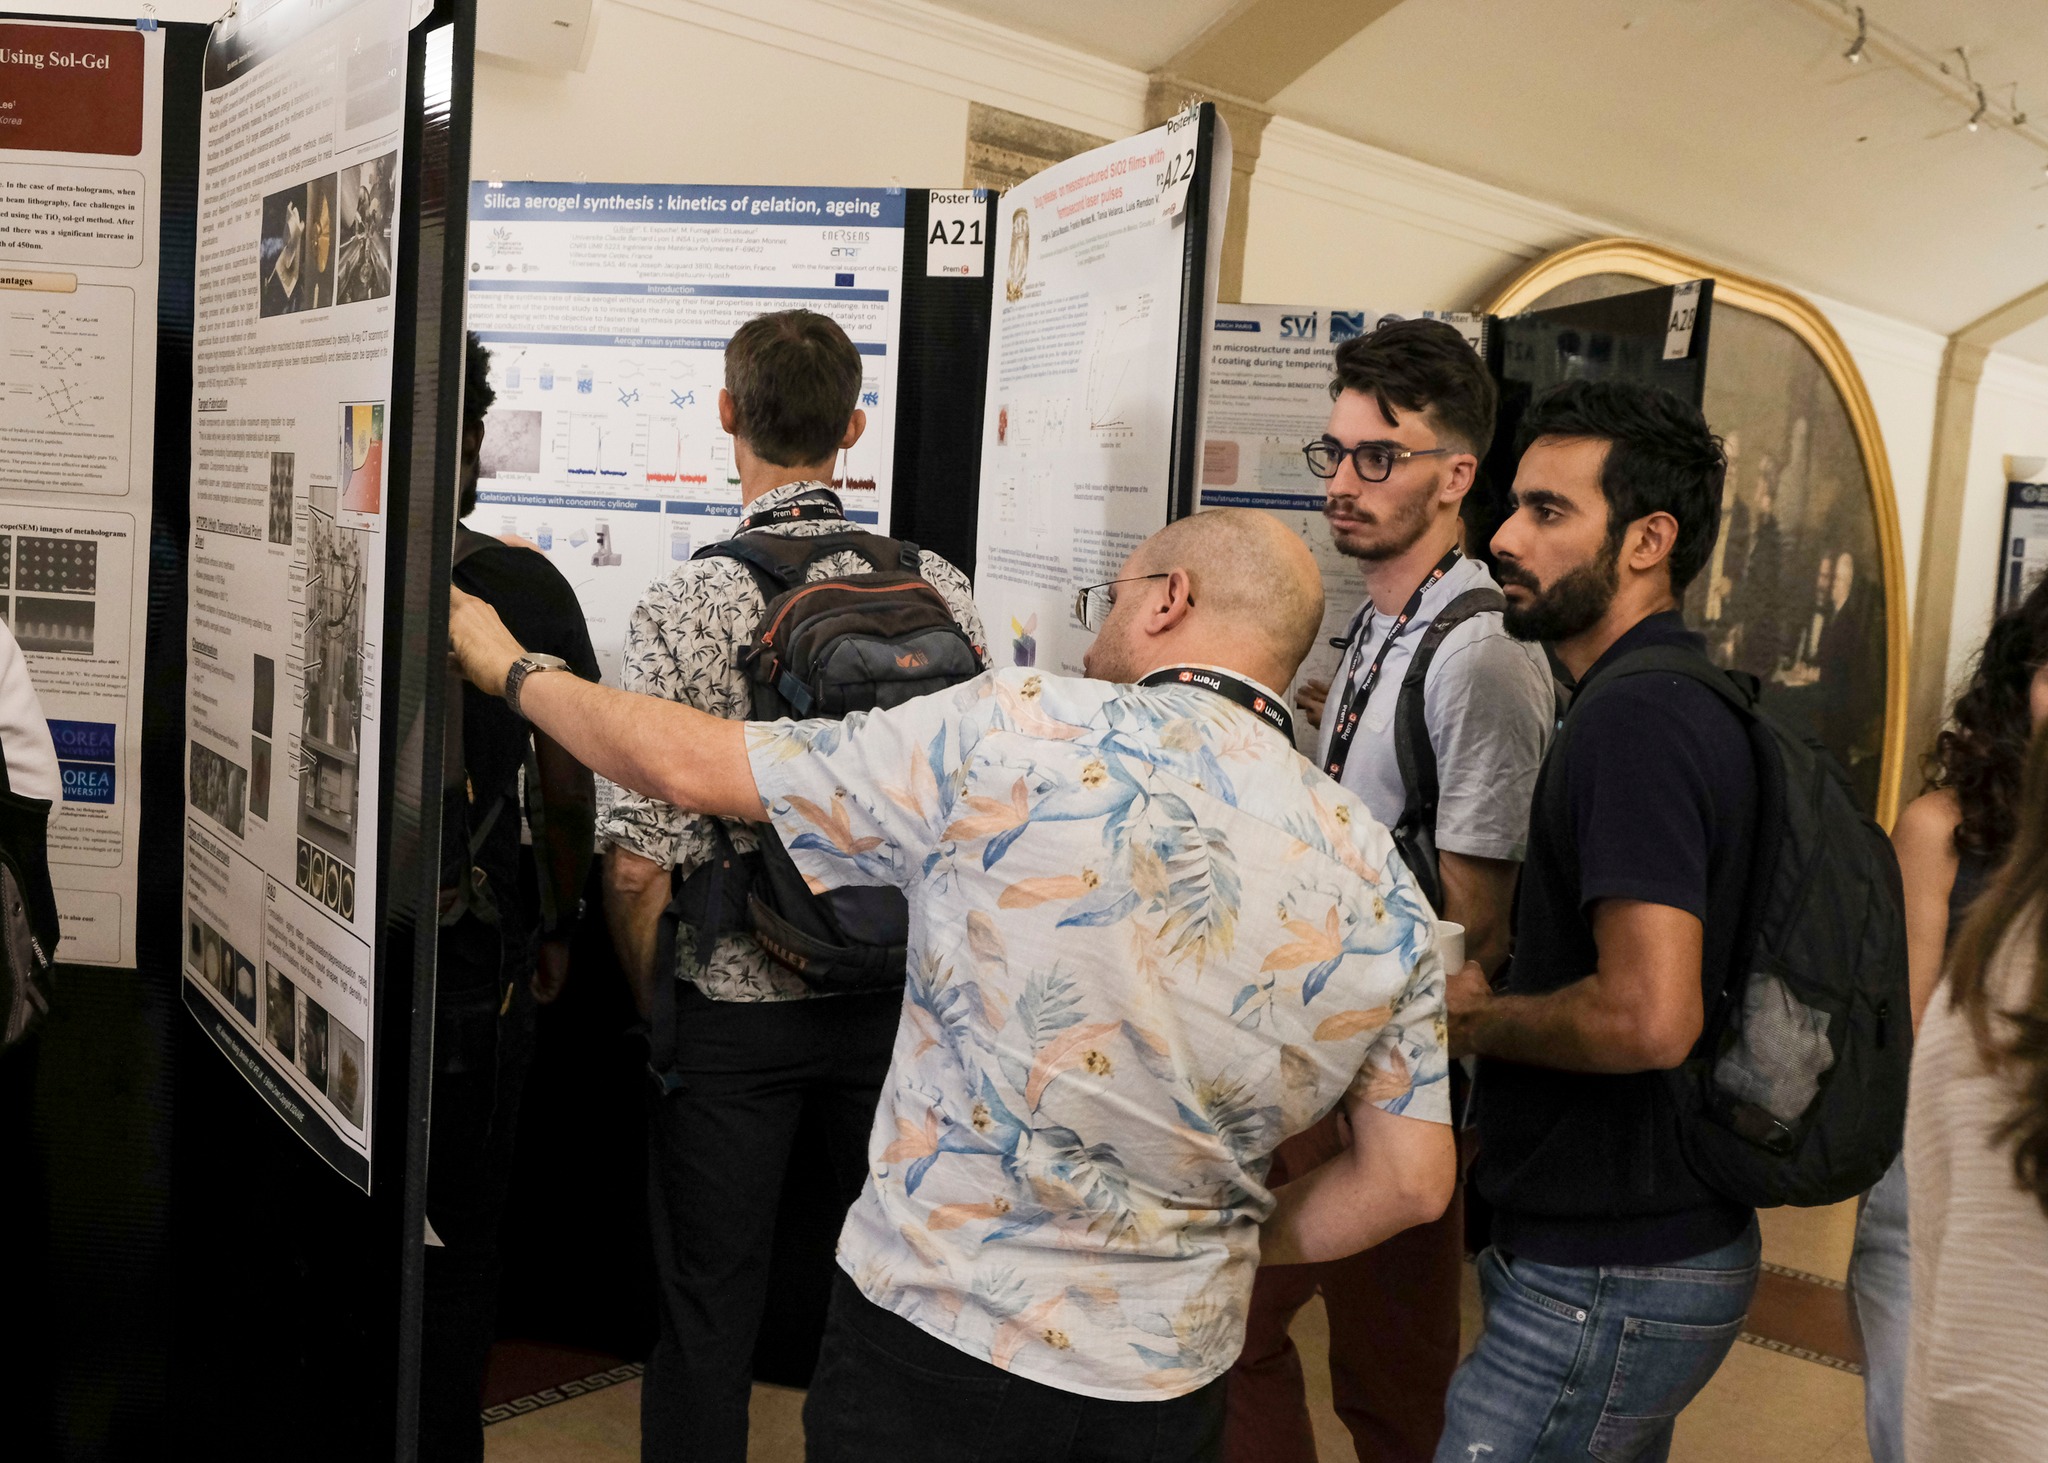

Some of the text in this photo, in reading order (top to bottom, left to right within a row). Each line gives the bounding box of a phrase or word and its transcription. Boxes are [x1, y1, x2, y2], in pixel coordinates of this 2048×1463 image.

[0, 48, 110, 70] Using Sol-Gel
[1110, 160, 1126, 178] SiO2
[1128, 156, 1146, 172] films
[1149, 147, 1165, 166] with
[1162, 148, 1194, 194] A22
[56, 184, 115, 195] meta-holograms,
[931, 192, 970, 204] Poster
[1100, 186, 1123, 206] pulses
[28, 198, 70, 208] lithography,
[90, 201, 126, 210] challenges
[484, 194, 880, 218] Silica aerogel synthesis : kinetics of gelation, ageing
[10, 212, 30, 220] using
[62, 216, 84, 224] sol-gel
[58, 230, 93, 238] significant
[96, 231, 124, 240] increase
[929, 220, 984, 244] A21
[0, 276, 33, 286] antages
[648, 284, 695, 294] Introduction
[614, 337, 644, 347] Aerogel
[664, 338, 701, 348] synthesis
[703, 340, 725, 349] steps
[1224, 344, 1290, 354] microstructure
[1294, 346, 1310, 355] and
[1218, 356, 1332, 372] coating during tempering
[480, 493, 638, 510] Gelation's kinetics with concentric cylinder
[1202, 495, 1250, 504] tress/structure
[1252, 497, 1290, 506] comparison
[1293, 500, 1310, 508] using
[705, 504, 738, 516] Ageing's
[0, 524, 38, 532] cope(SEM)
[40, 525, 64, 534] images
[74, 528, 126, 538] metaholograms
[62, 770, 110, 786] OREA
[62, 786, 109, 797] NIVERSITY
